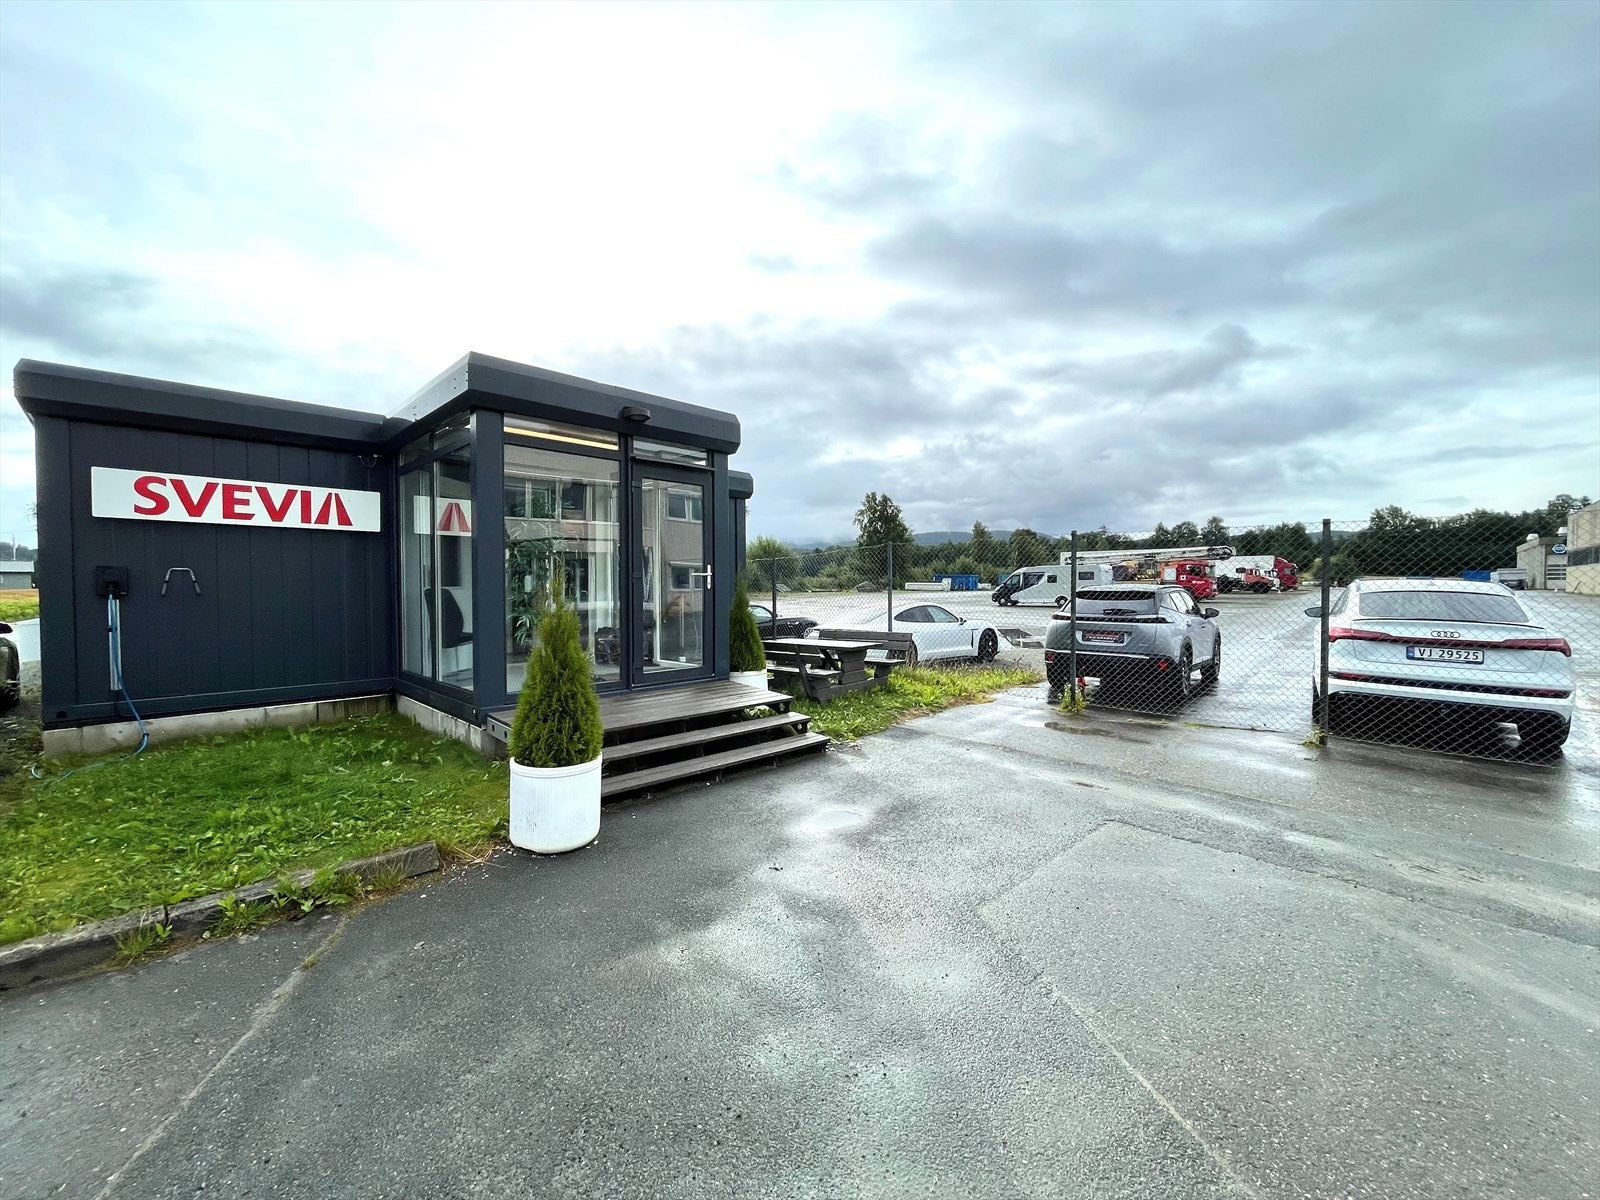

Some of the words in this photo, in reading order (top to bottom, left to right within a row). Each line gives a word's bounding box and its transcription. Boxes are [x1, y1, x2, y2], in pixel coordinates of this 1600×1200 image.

[133, 475, 353, 526] SVEVIA
[1418, 648, 1432, 657] VJ
[1438, 649, 1479, 660] 29525
